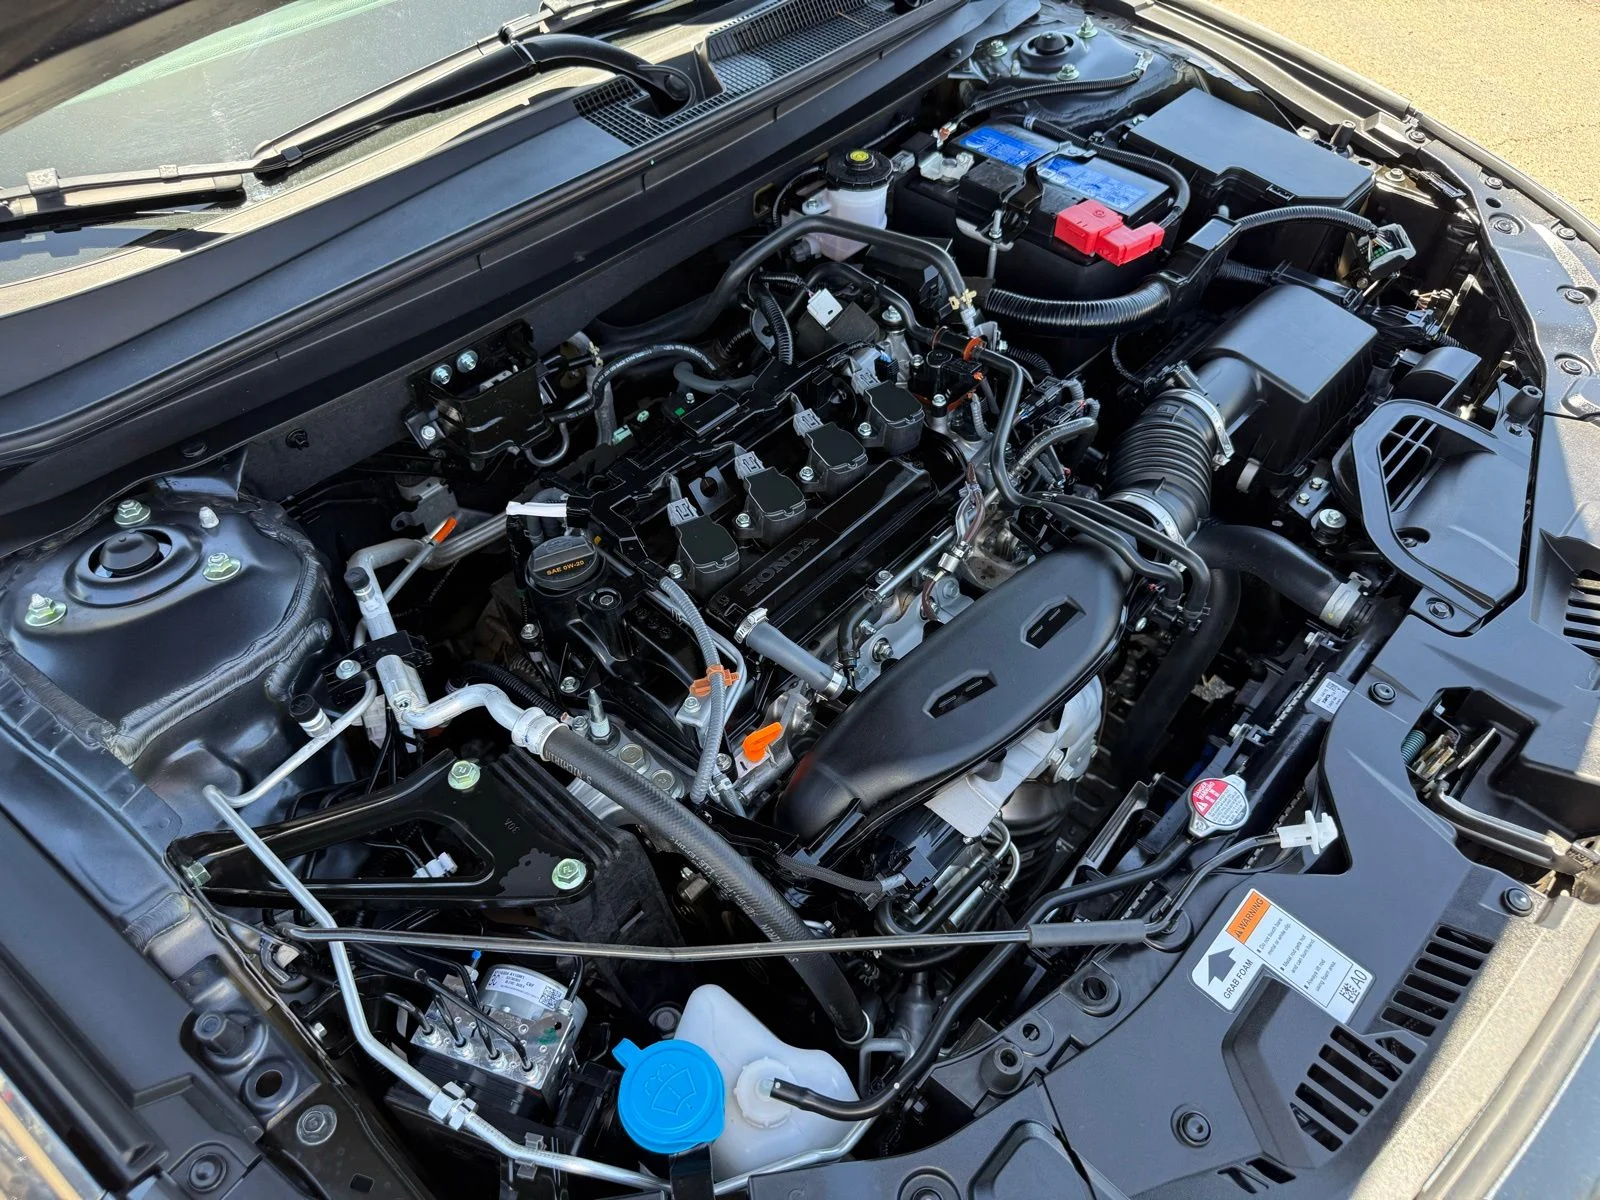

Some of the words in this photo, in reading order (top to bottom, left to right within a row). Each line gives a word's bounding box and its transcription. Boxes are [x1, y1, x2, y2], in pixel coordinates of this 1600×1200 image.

[546, 567, 561, 575] SAE
[562, 559, 584, 570] 0W-20
[741, 538, 819, 596] HONDA
[1238, 897, 1263, 930] WARNING
[1222, 977, 1239, 999] GRAB
[1235, 958, 1253, 979] FOAM
[1353, 969, 1367, 986] A0
